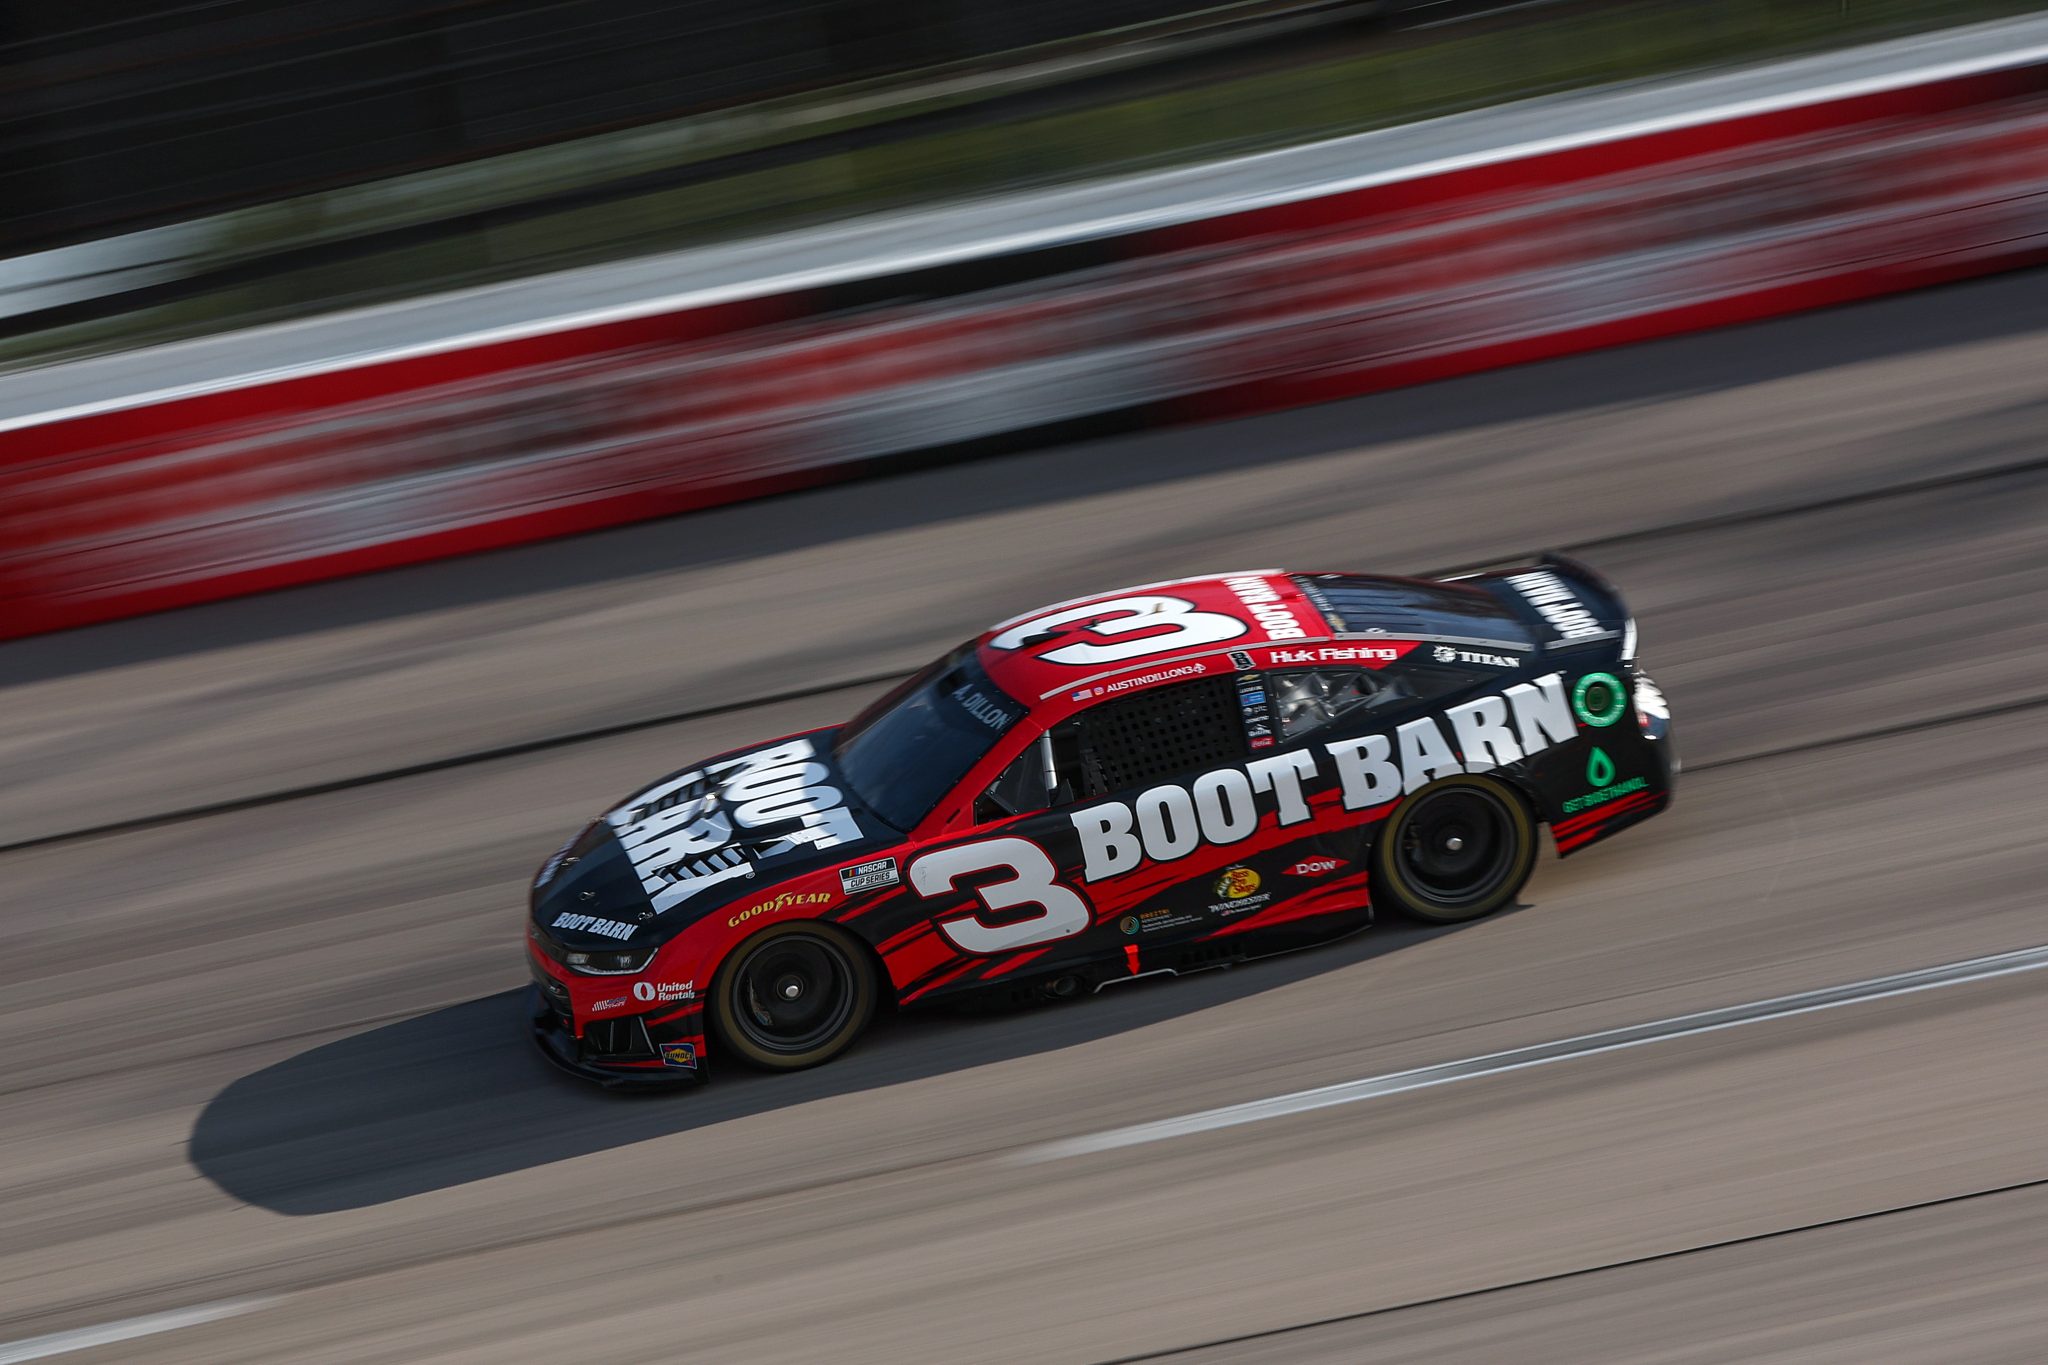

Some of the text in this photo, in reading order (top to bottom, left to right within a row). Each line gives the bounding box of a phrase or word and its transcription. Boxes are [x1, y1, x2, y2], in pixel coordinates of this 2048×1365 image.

[1220, 576, 1282, 605] BARN
[988, 594, 1249, 665] 3
[1245, 603, 1307, 641] BOOT
[1535, 602, 1606, 639] BOOT
[1270, 650, 1315, 664] Huk
[1319, 648, 1398, 661] Fishing
[1460, 652, 1521, 668] TITAN
[1106, 666, 1194, 693] AUSTINDILLON3
[962, 692, 1009, 730] DILLON
[1070, 672, 1579, 883] BOOT BARN
[703, 738, 865, 860] BOOT
[850, 872, 890, 888] CUP SERIES
[858, 861, 888, 875] NASCAR
[728, 891, 831, 928] GOODYEAR
[908, 837, 1091, 954] 3
[551, 912, 638, 941] BOOT BARN
[657, 980, 693, 993] United
[658, 990, 696, 1001] Rentals
